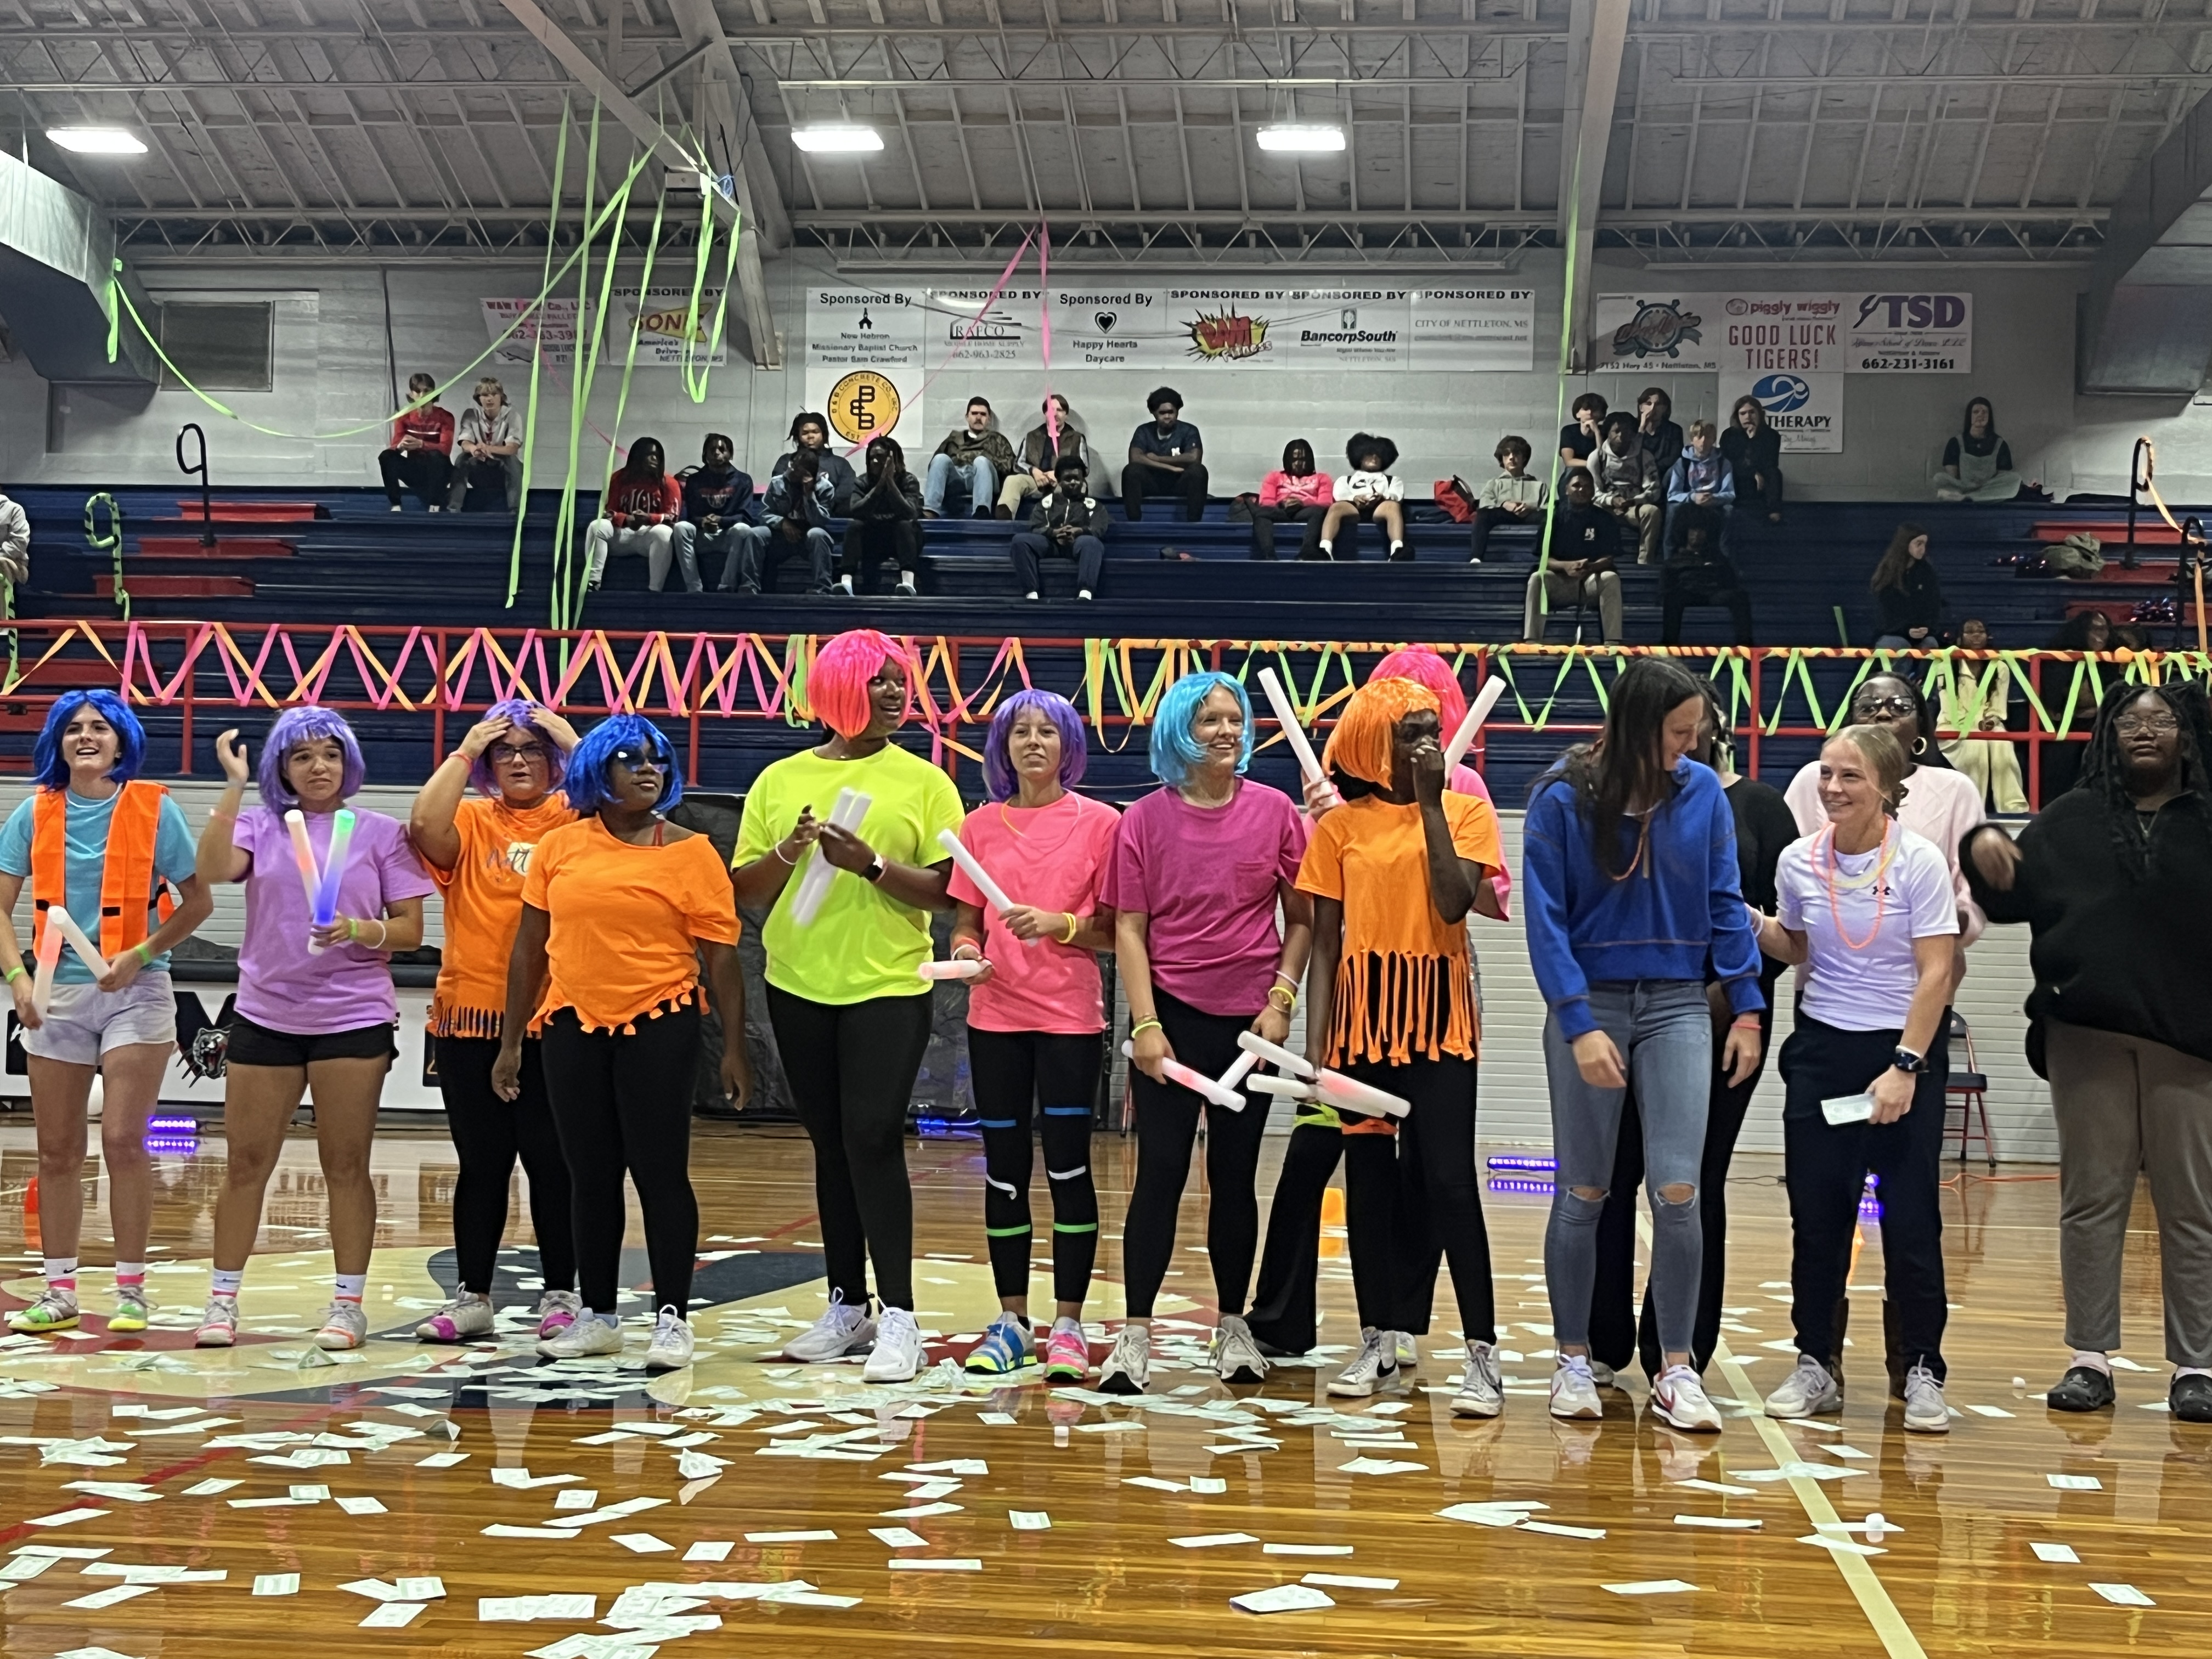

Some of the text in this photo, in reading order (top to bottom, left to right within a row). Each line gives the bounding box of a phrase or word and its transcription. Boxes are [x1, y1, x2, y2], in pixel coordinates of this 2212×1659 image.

[820, 294, 911, 307] Sponsored By
[1060, 293, 1152, 307] Sponsored By
[1751, 300, 1840, 315] piggly wiggly
[1301, 330, 1396, 344] BancorpSouth
[1729, 325, 1779, 345] GOOD
[1790, 325, 1836, 345] LUCK
[1073, 340, 1138, 350] Happy Hearts
[1086, 354, 1125, 364] Daycare
[1746, 348, 1819, 369] TIGERS!
[1862, 358, 1954, 369] 662-231-3161
